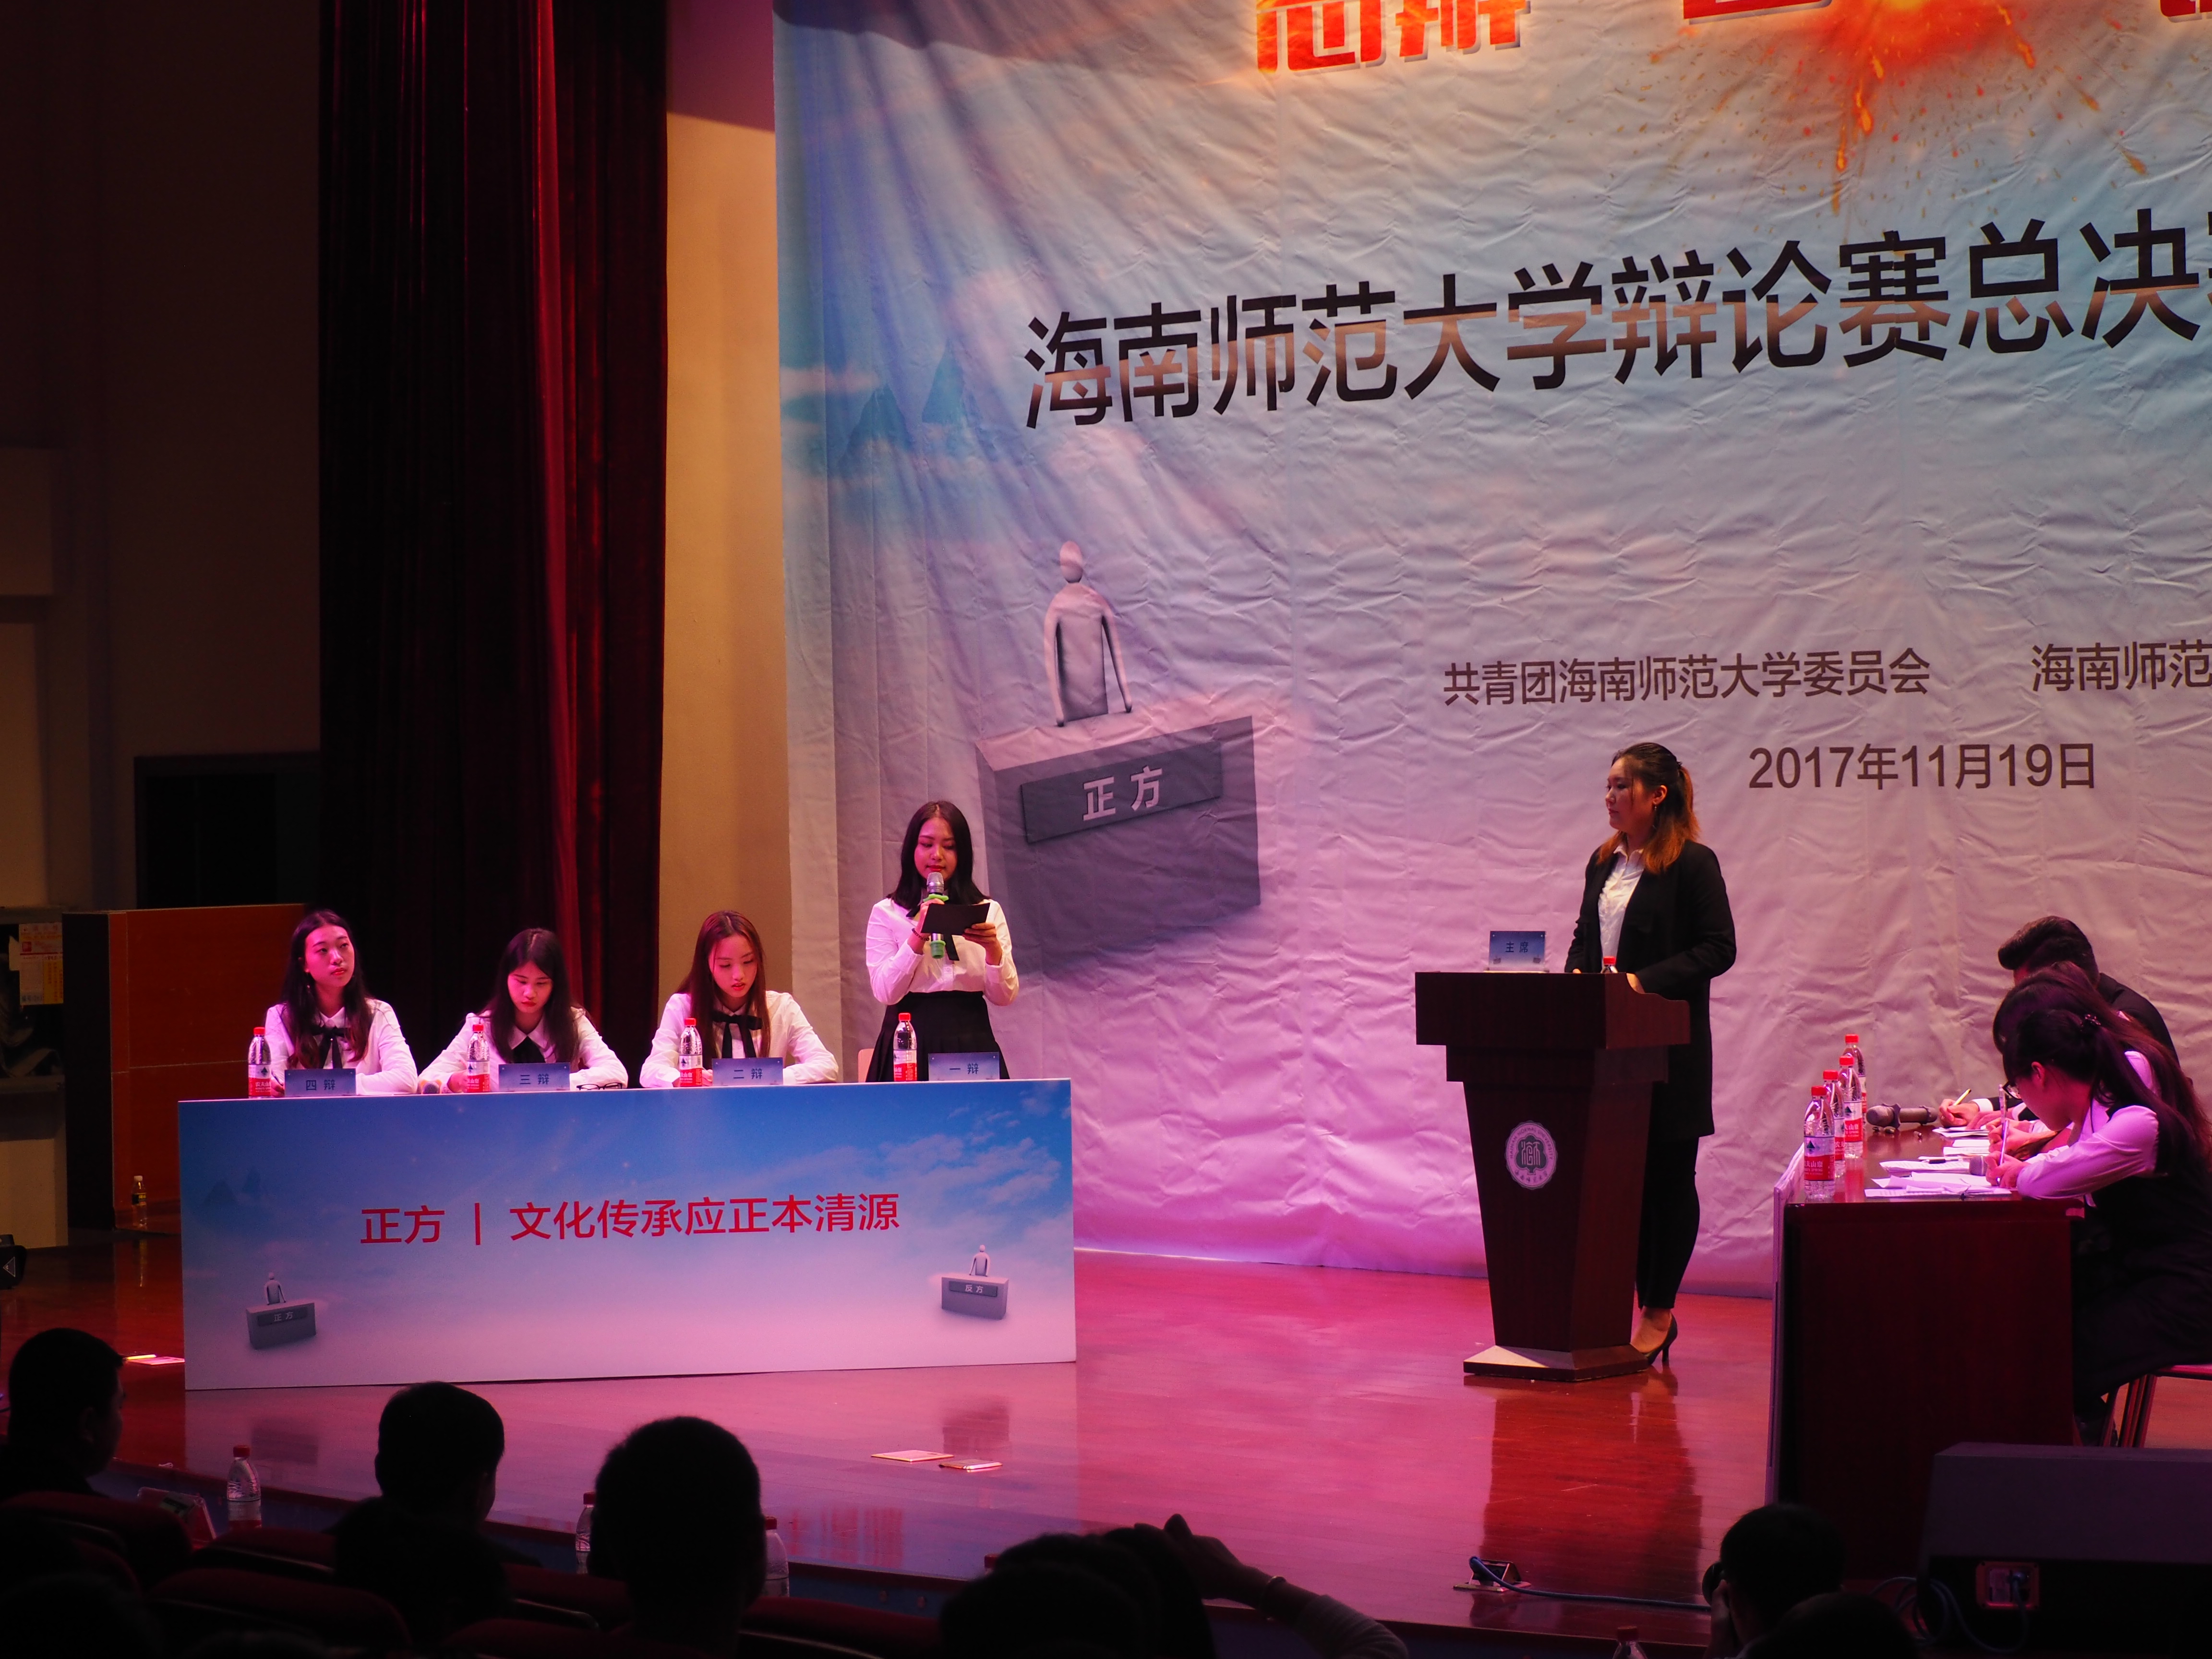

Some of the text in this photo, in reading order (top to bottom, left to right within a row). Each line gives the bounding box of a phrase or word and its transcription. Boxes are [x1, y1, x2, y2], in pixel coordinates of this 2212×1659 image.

[1024, 208, 2212, 429] 海南师范大学辩论赛总决
[2031, 638, 2212, 692] 海南师范
[1443, 648, 1931, 707] 共青团海南师范大学委员会
[1749, 742, 2095, 790] 2017年11月19日
[1083, 765, 1164, 821] 正方
[1504, 941, 1529, 954] 主席
[733, 1068, 763, 1080] 二辩
[949, 1062, 979, 1075] 一辩
[306, 1079, 336, 1091] 四辩
[519, 1073, 550, 1085] 三辩
[360, 1205, 445, 1245] 正方
[510, 1192, 901, 1241] 文化传承应正本清源
[965, 1284, 984, 1293] 反方
[274, 1311, 293, 1322] 正方
